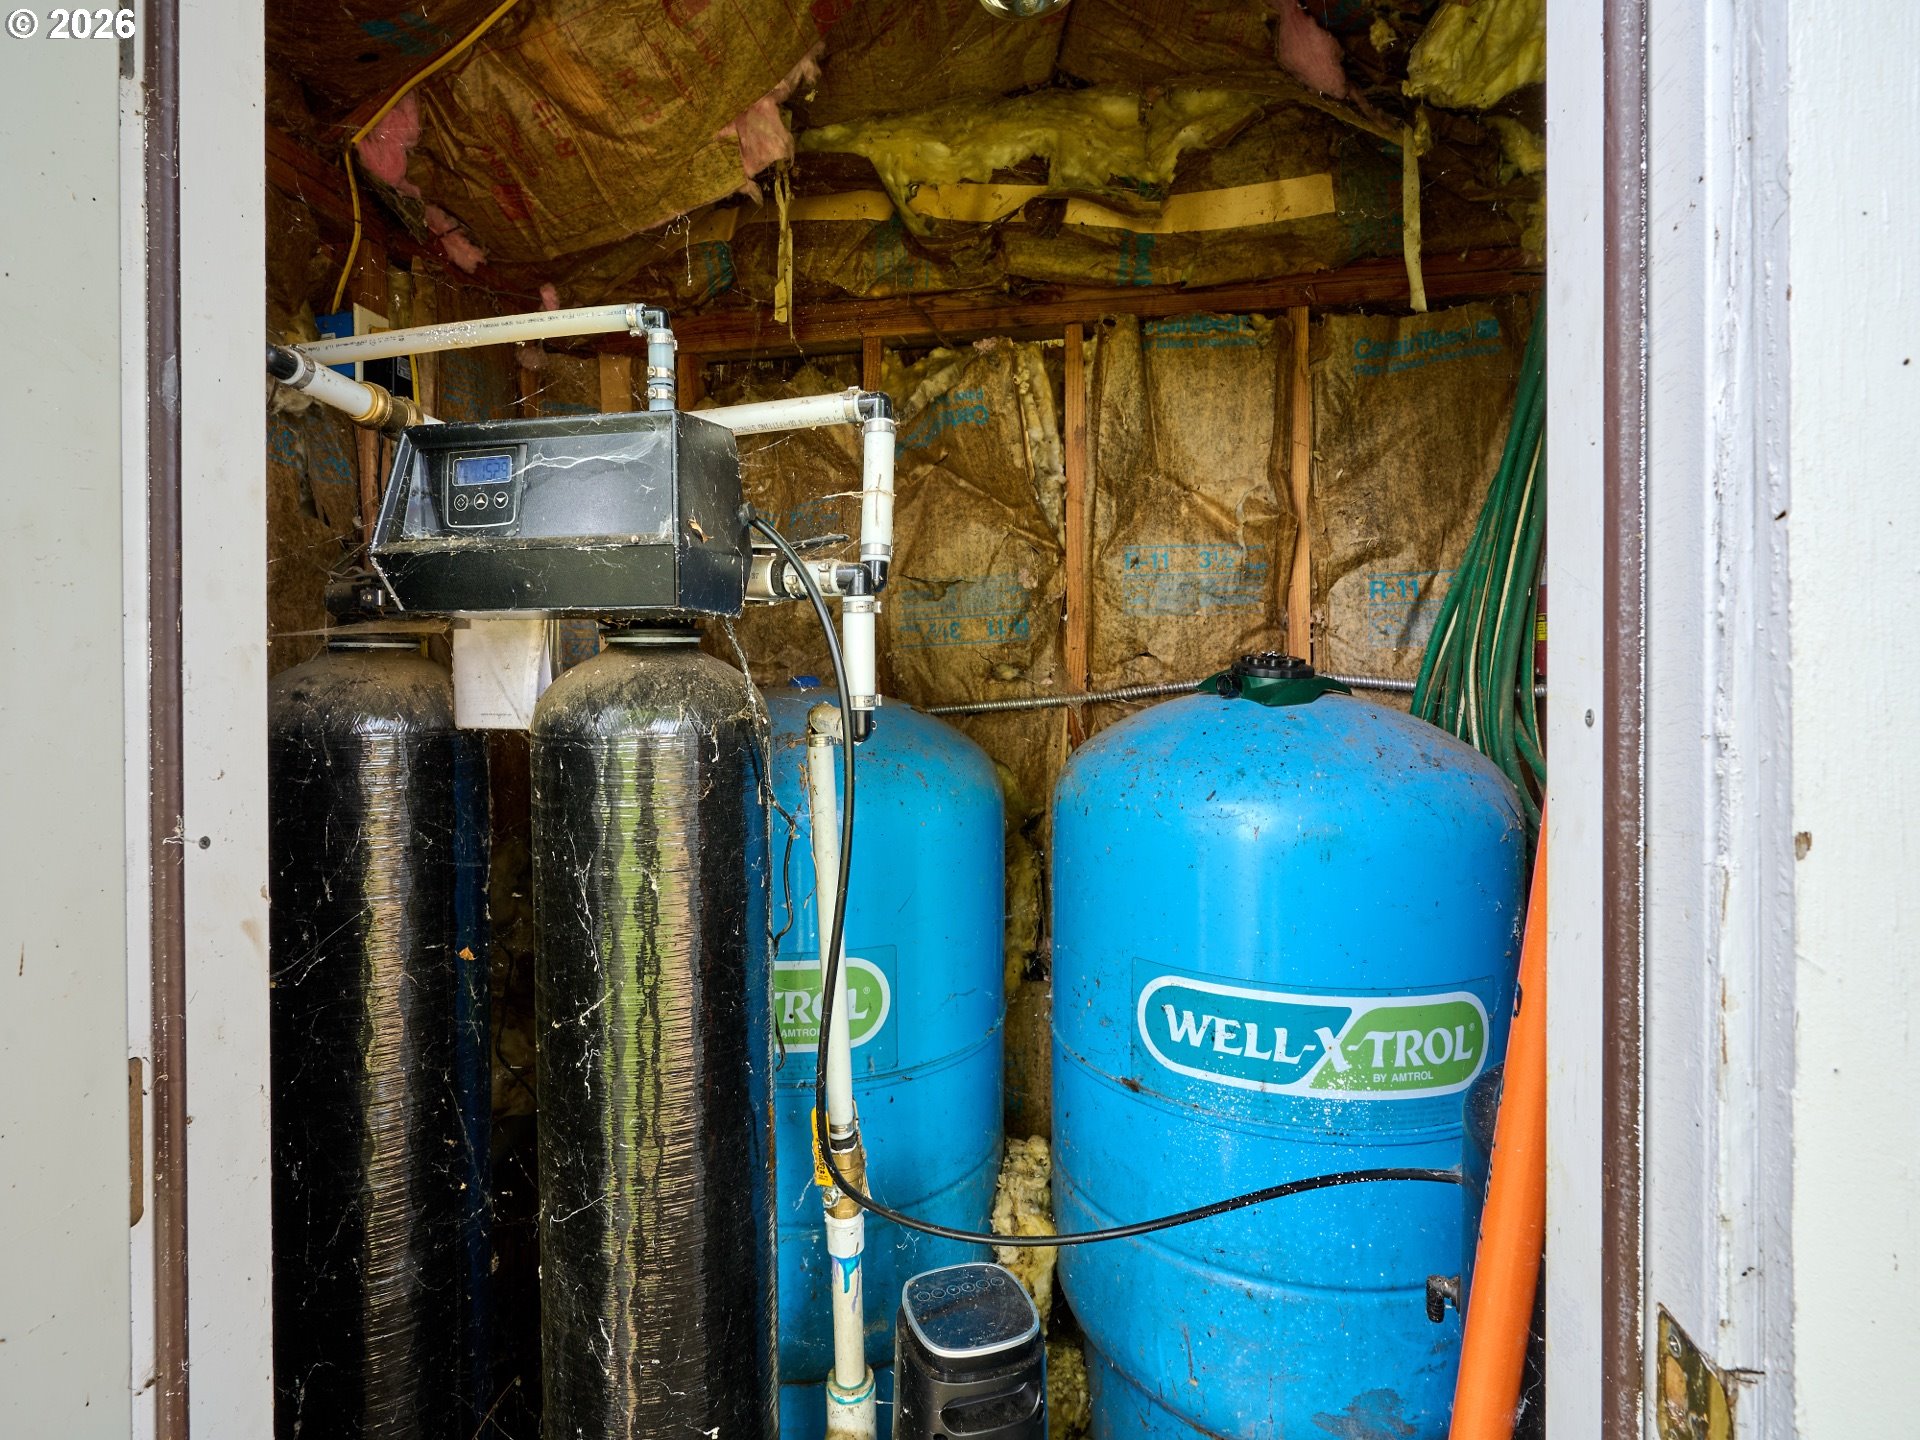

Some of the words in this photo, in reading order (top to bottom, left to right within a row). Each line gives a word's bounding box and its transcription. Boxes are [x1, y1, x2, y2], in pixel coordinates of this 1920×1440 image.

[1369, 579, 1419, 599] R-11
[1161, 1004, 1474, 1073] WELL-X-TROL
[1373, 1073, 1387, 1083] BY
[1391, 1071, 1434, 1083] AMTROL
